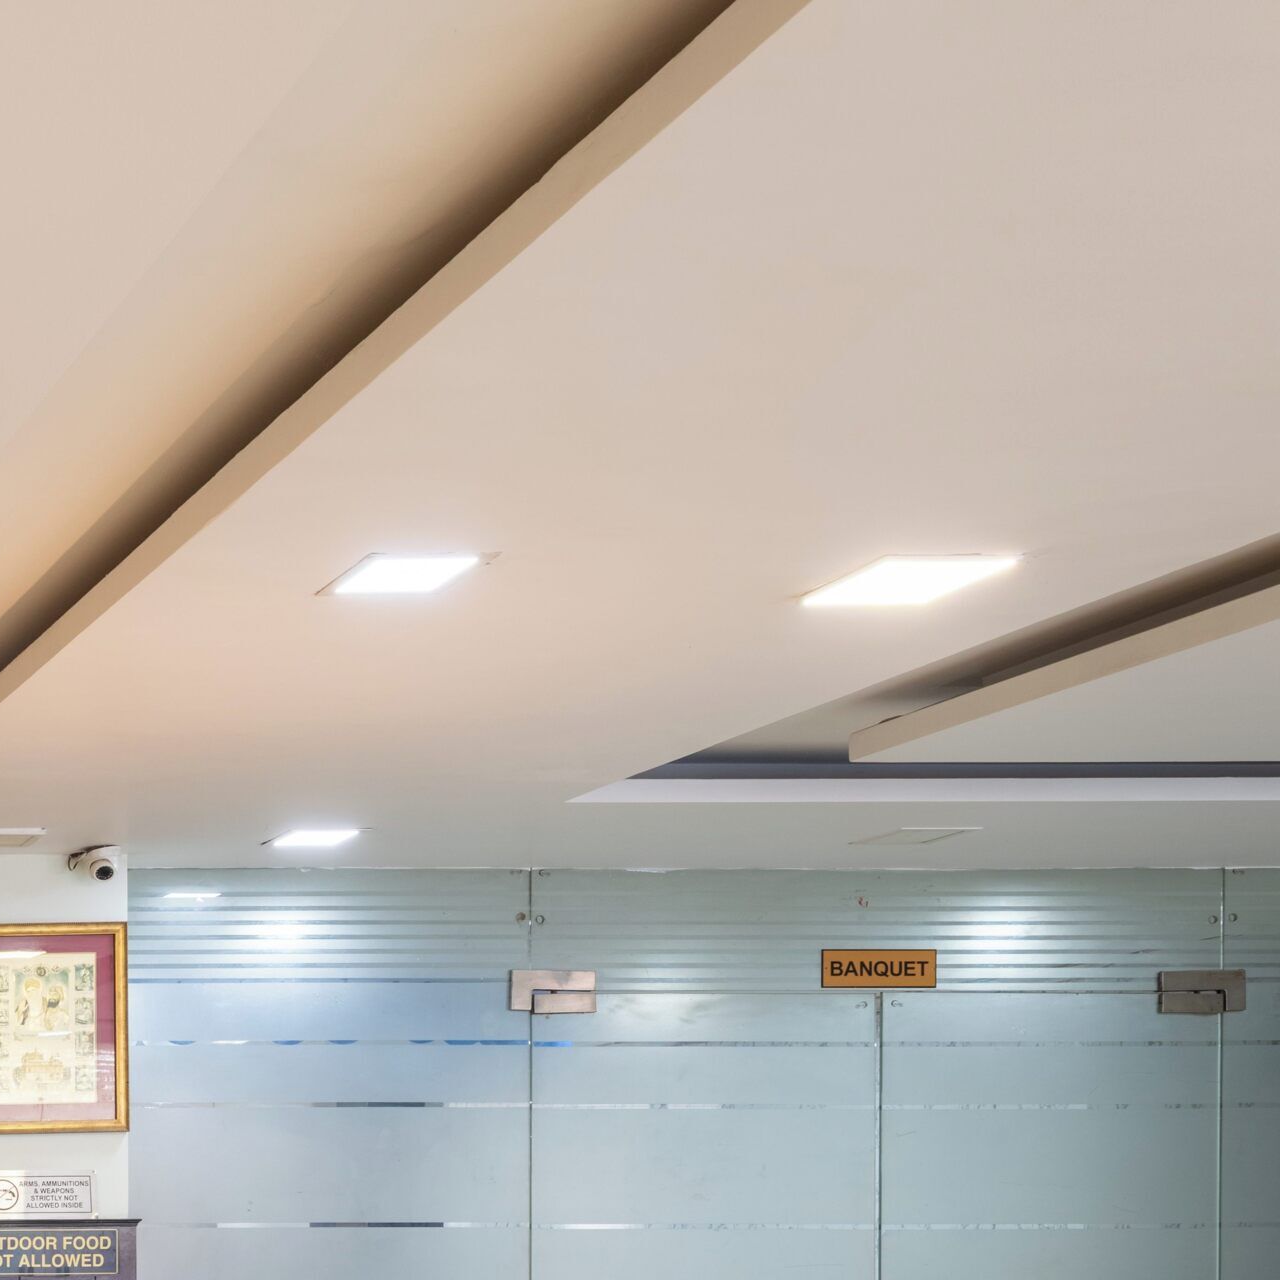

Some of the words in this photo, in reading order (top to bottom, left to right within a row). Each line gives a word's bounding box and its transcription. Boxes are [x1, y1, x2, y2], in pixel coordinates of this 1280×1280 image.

[830, 960, 929, 978] BANQUET
[62, 1236, 112, 1250] FOOD
[18, 1254, 105, 1268] ALLOWED
